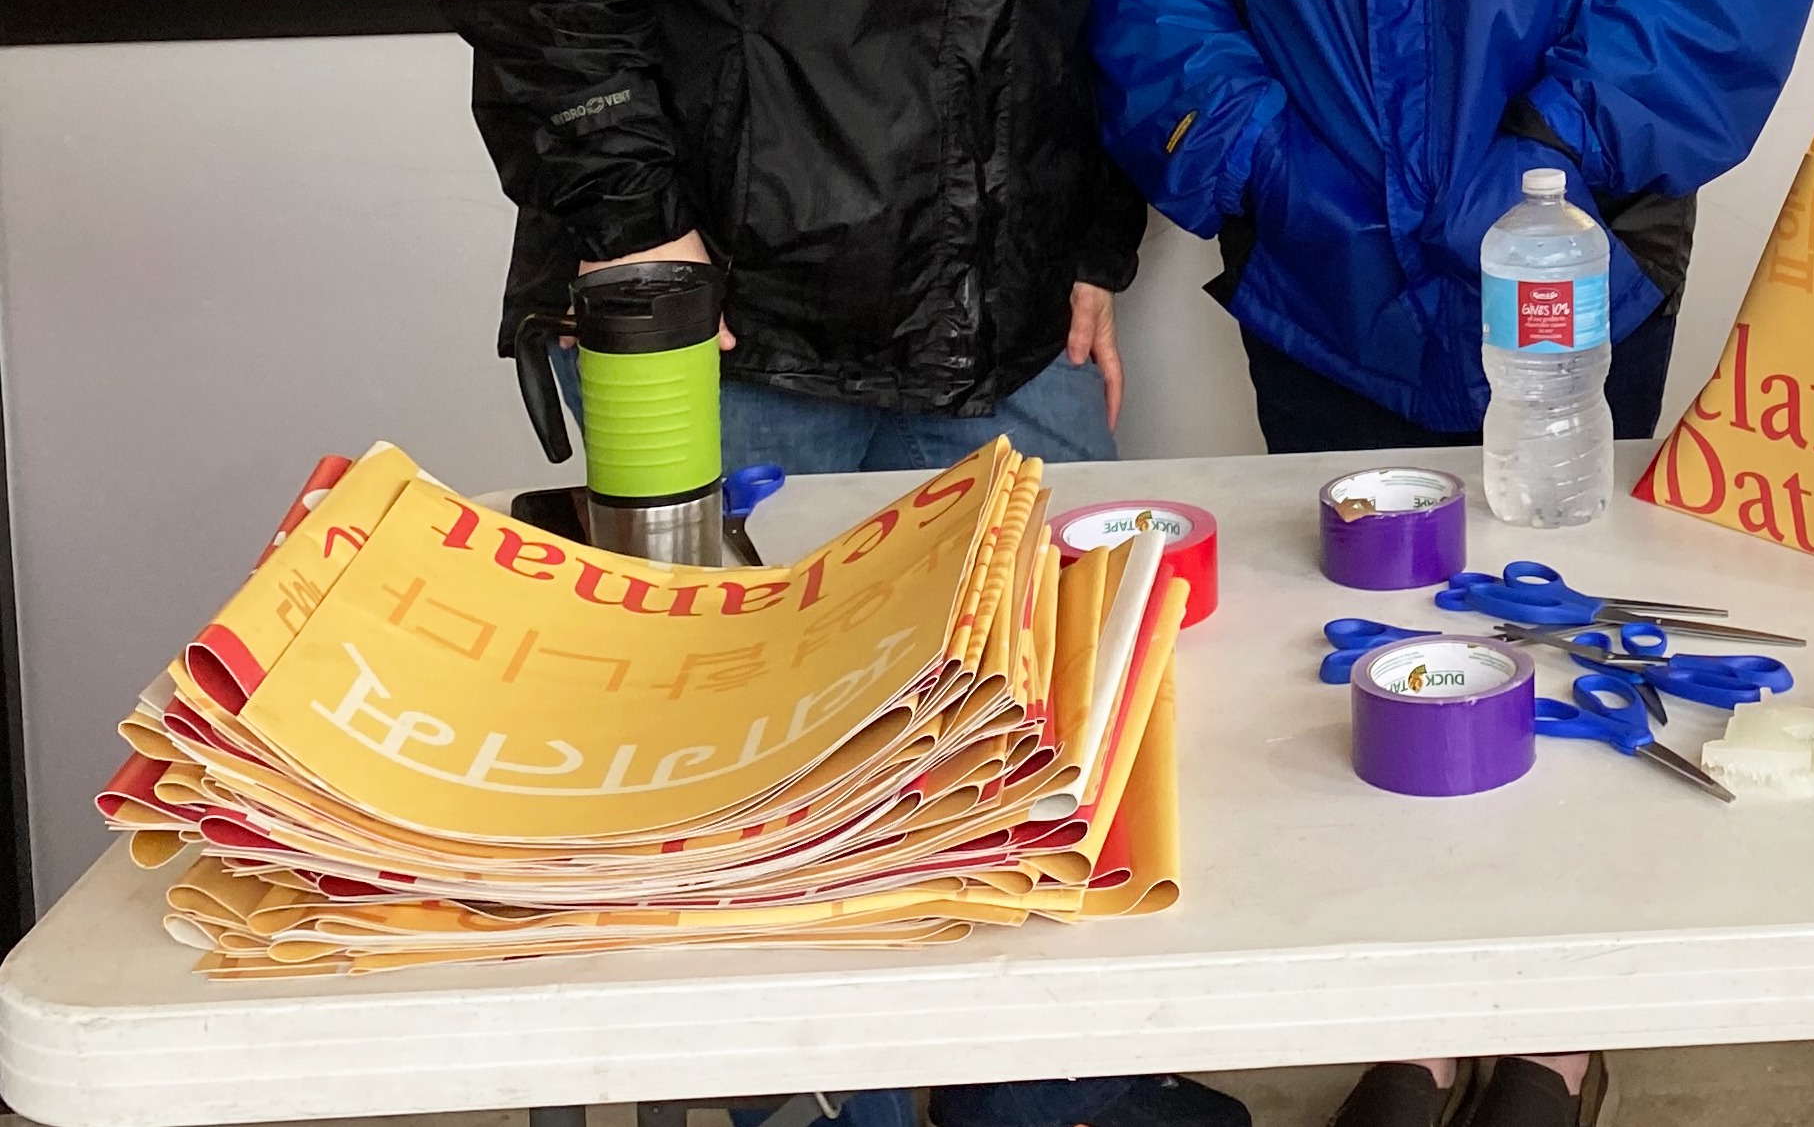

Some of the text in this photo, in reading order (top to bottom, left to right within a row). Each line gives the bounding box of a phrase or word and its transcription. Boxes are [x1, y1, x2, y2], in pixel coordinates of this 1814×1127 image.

[431, 453, 979, 619] Selamat
[1103, 520, 1136, 535] TAPE
[1388, 673, 1465, 693] DUCK TA
